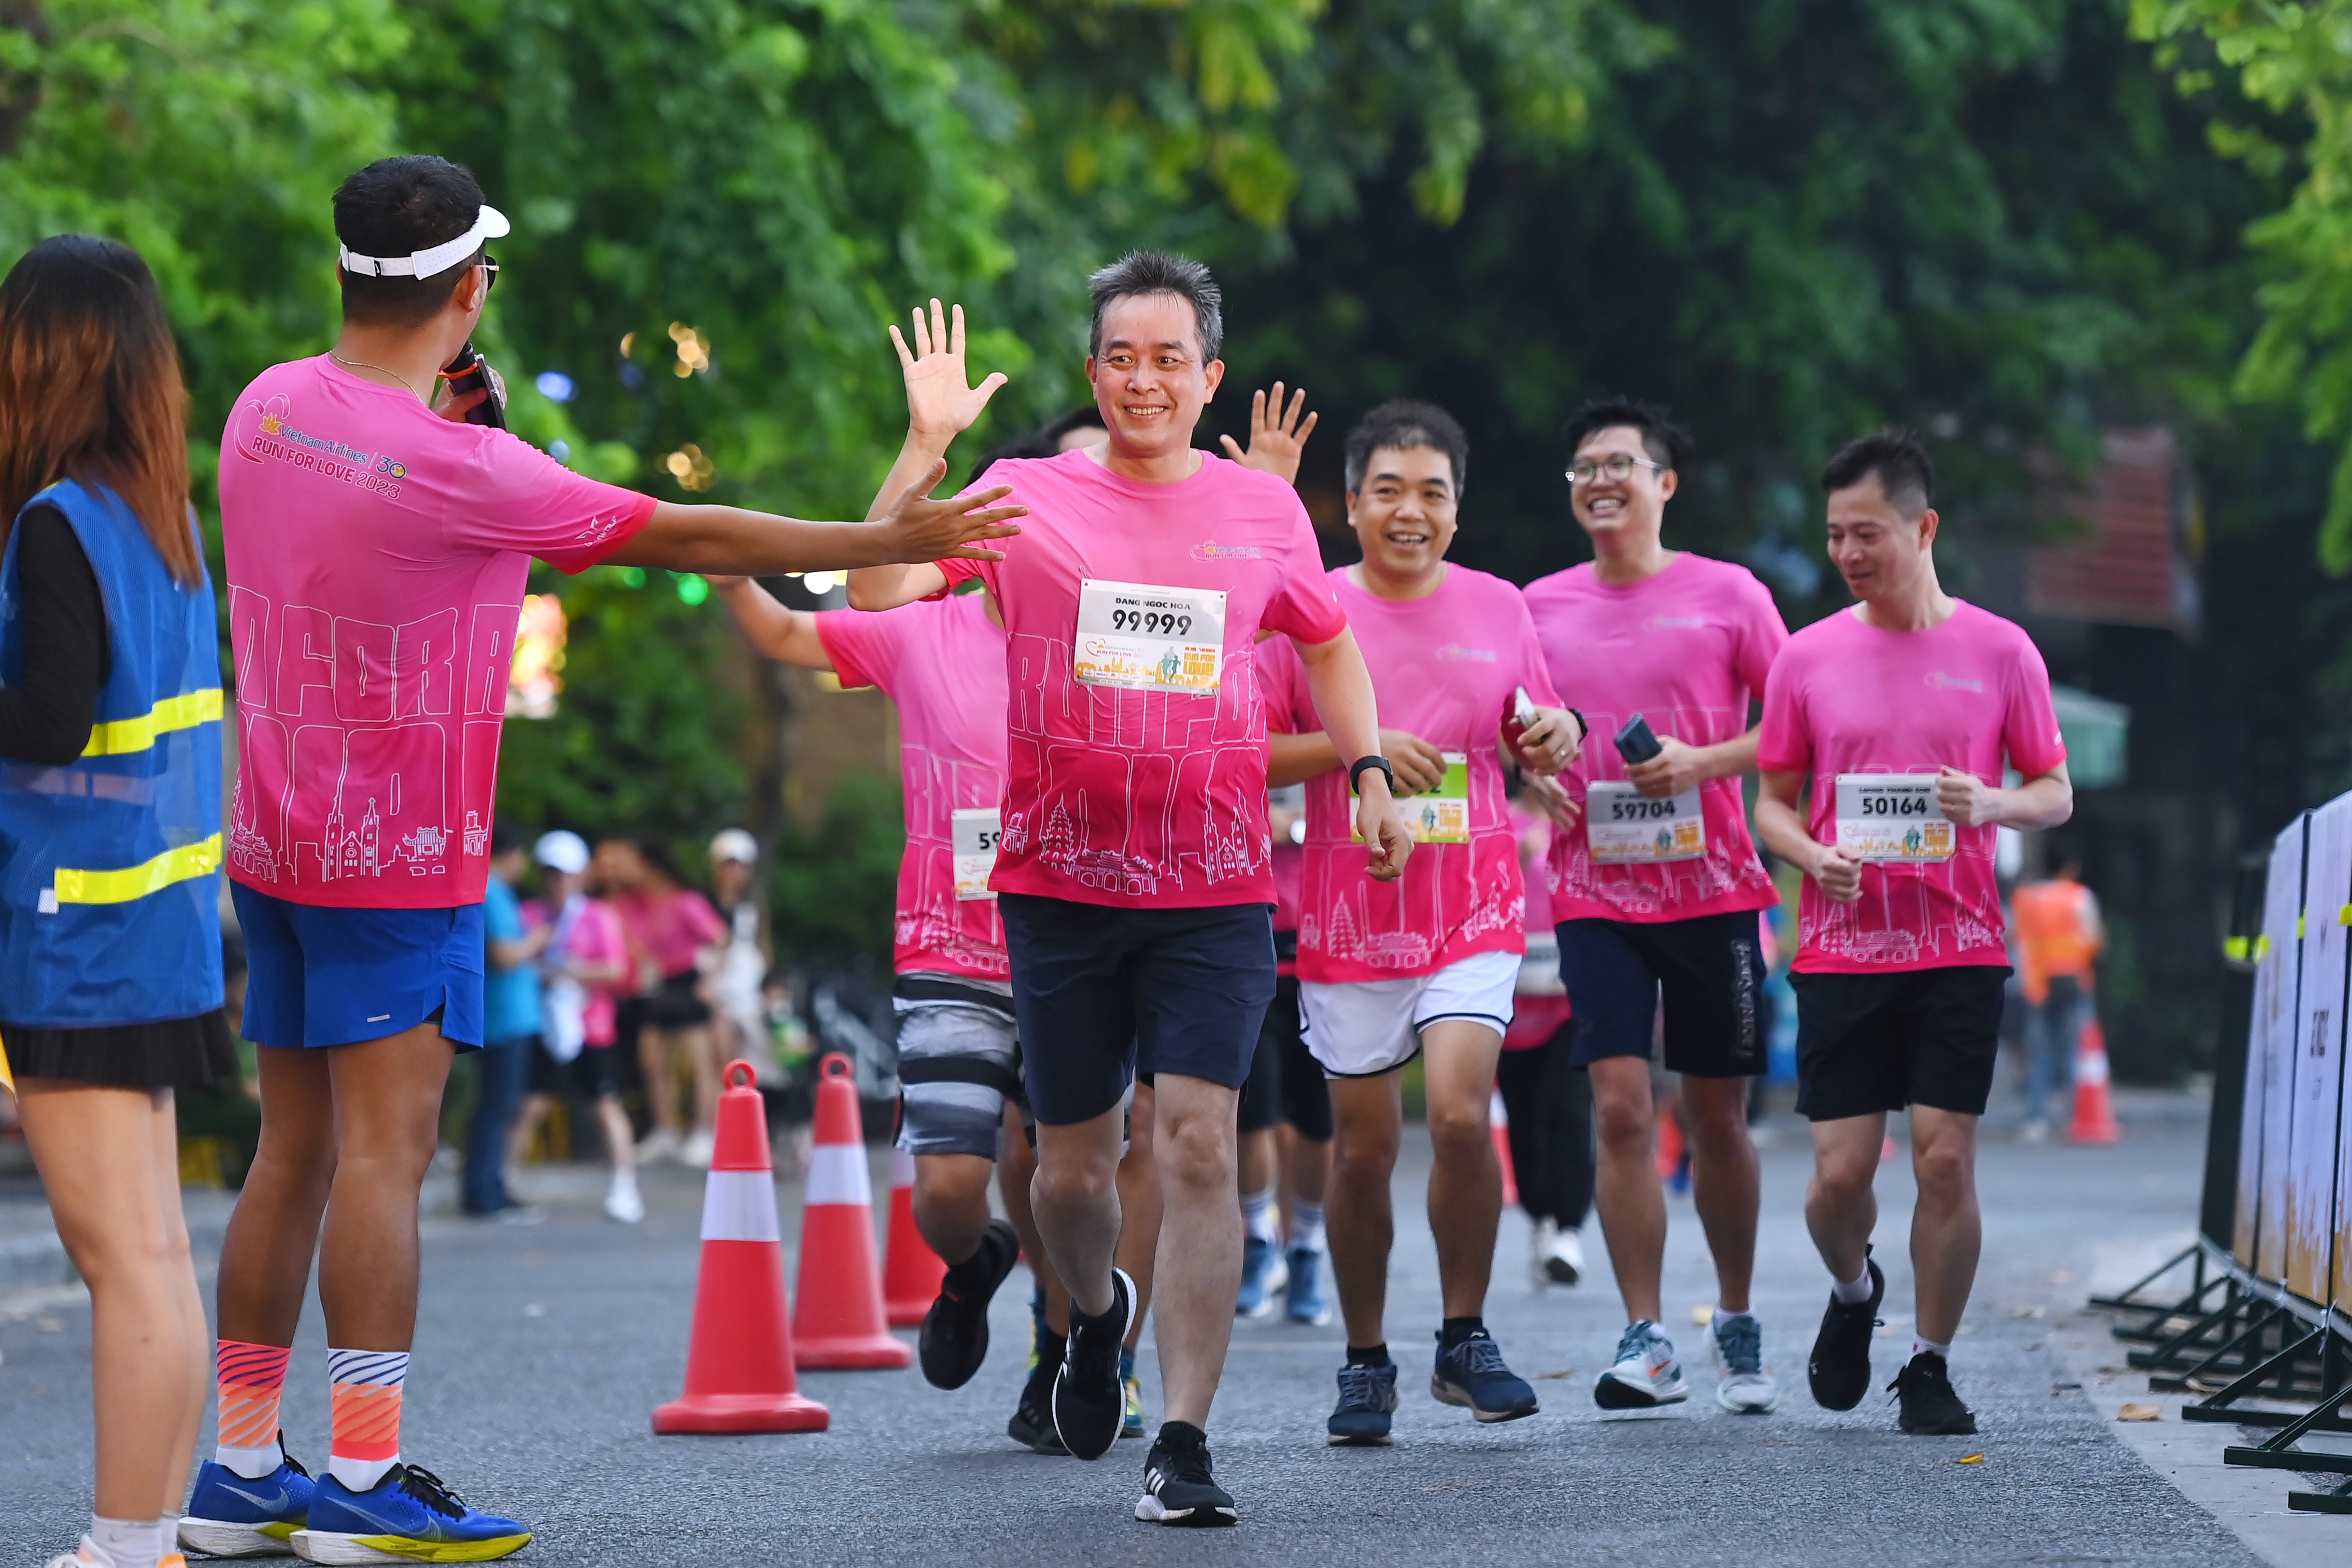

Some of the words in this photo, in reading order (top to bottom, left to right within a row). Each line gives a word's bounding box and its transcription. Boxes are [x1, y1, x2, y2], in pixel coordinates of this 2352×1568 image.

[251, 435, 285, 460] RUN
[286, 448, 316, 471] FOR
[315, 458, 357, 483] LOVE
[356, 472, 402, 500] 2023
[1115, 597, 1140, 606] DANG
[1143, 600, 1168, 608] NGOC
[1170, 602, 1191, 610] HOA
[1112, 609, 1192, 636] 99999
[1612, 800, 1677, 821] 59704
[1862, 796, 1929, 816] 50164
